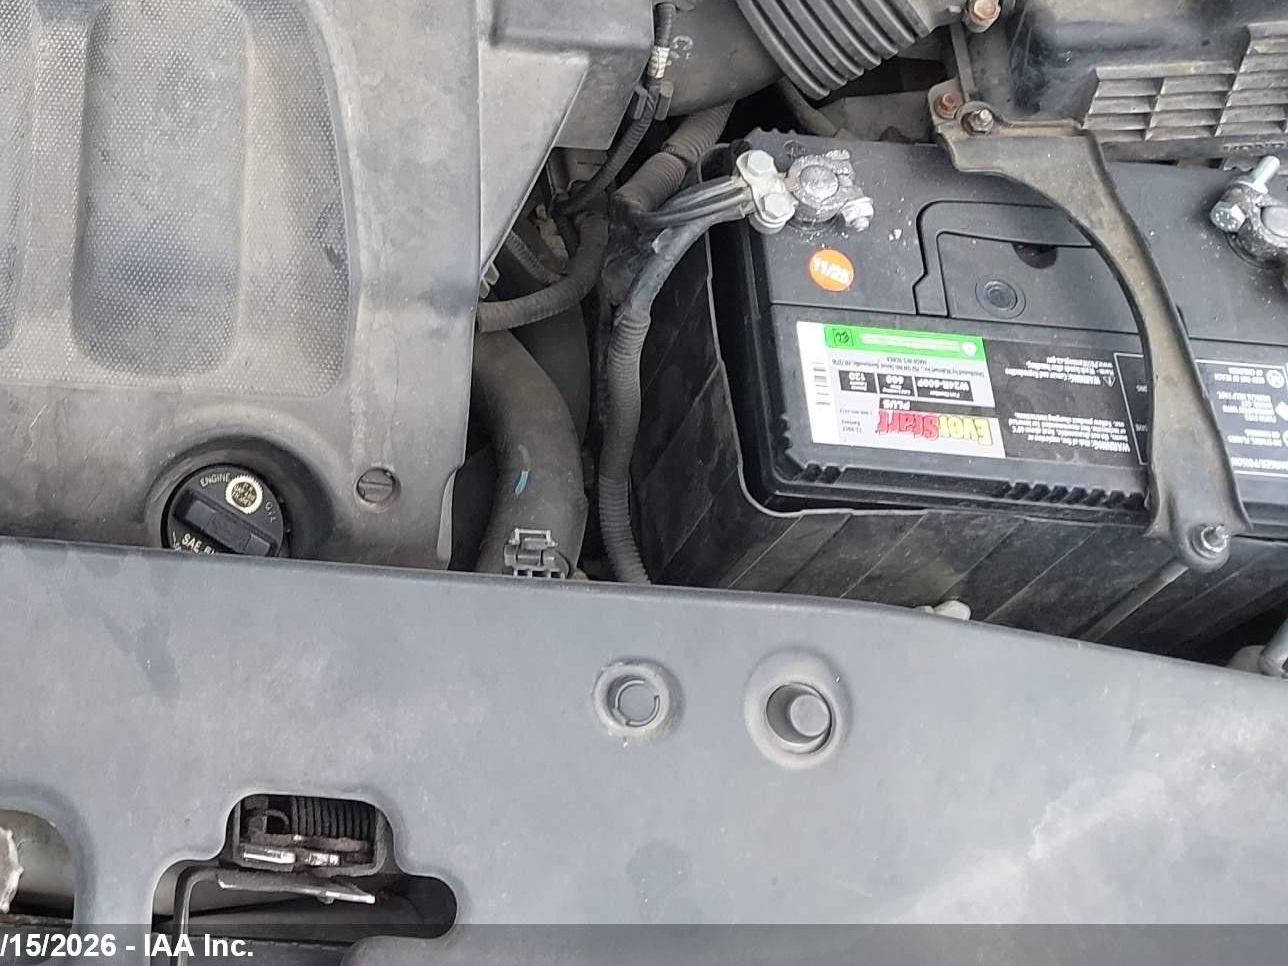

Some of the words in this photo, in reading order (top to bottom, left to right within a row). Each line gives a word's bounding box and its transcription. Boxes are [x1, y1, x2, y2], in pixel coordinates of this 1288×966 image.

[848, 372, 866, 382] 120
[1005, 367, 1040, 378] Reproductive
[1040, 371, 1049, 379] and
[1050, 371, 1068, 381] Cancer
[883, 397, 911, 411] PLUS
[1072, 417, 1093, 426] product
[878, 410, 994, 446] EverStart
[1092, 440, 1131, 453] WARNING:
[200, 472, 230, 488] ENGINE
[181, 533, 203, 553] SAE
